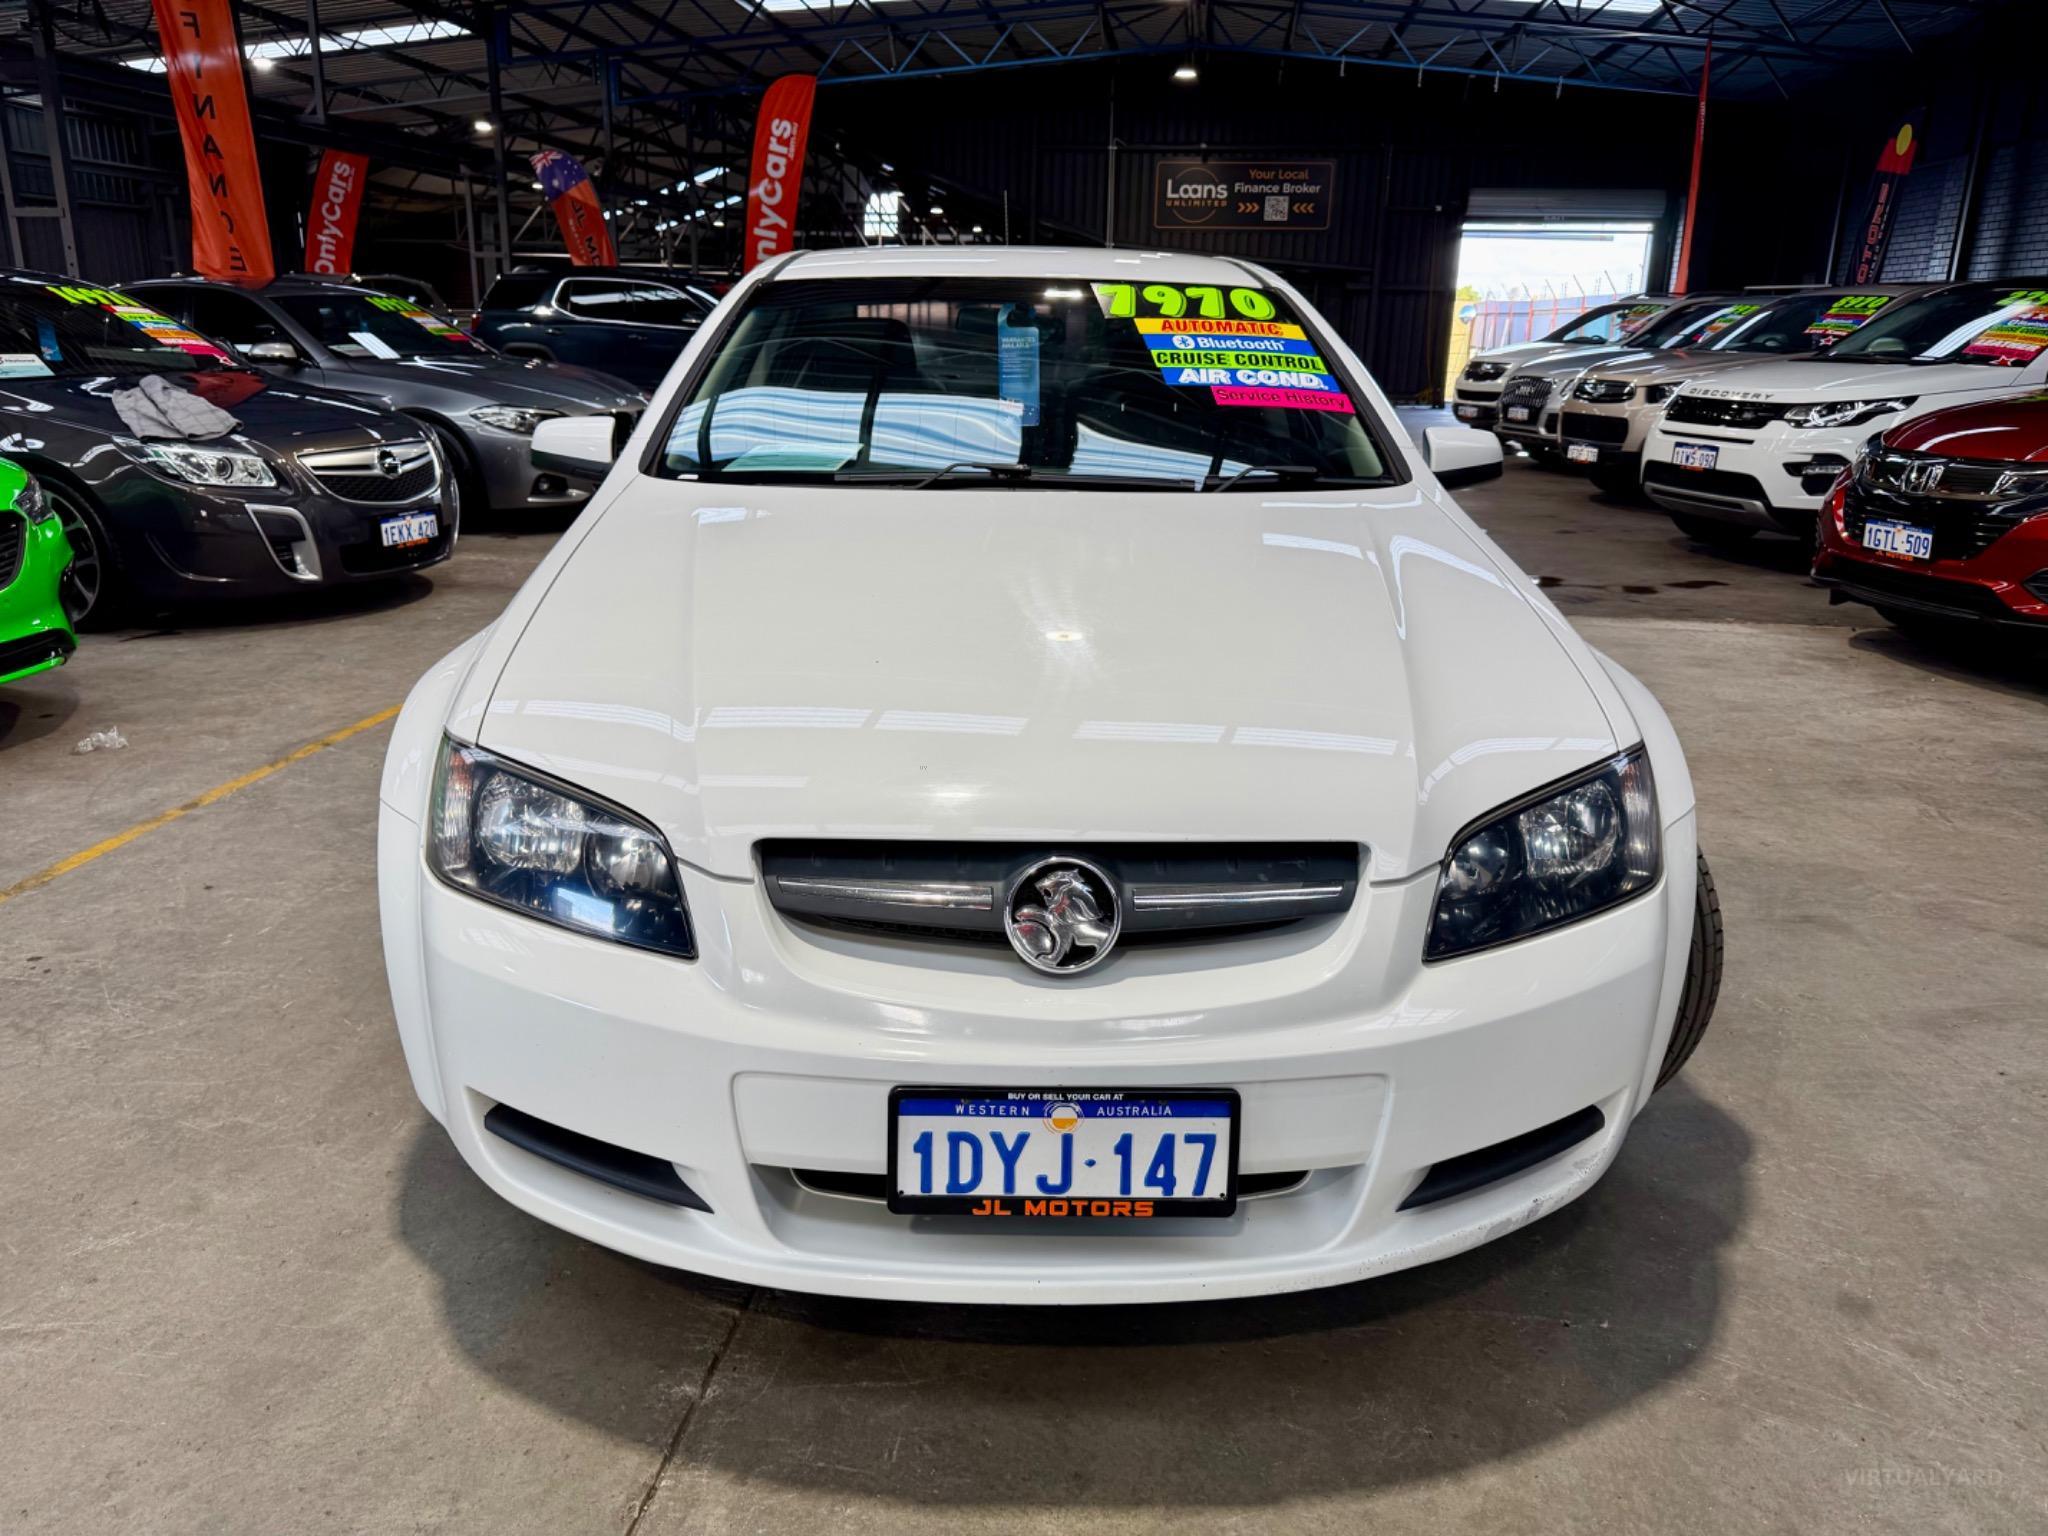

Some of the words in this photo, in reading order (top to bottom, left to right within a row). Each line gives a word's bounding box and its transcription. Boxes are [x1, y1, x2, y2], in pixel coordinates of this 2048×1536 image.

[1249, 168, 1275, 180] Your
[1279, 168, 1309, 180] Local
[1166, 178, 1229, 200] Loans
[1234, 182, 1280, 194] Finance
[1283, 182, 1321, 195] Broker
[1165, 200, 1228, 208] UNLIMITED
[1098, 283, 1276, 321] 7970
[1161, 319, 1284, 336] AUTOMATIC
[1197, 336, 1285, 352] Bluetooth
[1156, 351, 1229, 366] CRUISE
[1234, 353, 1322, 371] CONTROL
[1178, 368, 1232, 386] AIR
[1236, 369, 1329, 390] COND.
[1216, 389, 1280, 403] Service
[1285, 394, 1346, 409] History
[1688, 387, 1775, 401] DISCOVERY
[1008, 1092, 1026, 1100] BUY
[1028, 1092, 1041, 1100] OR
[1042, 1092, 1064, 1101] SELL
[1066, 1093, 1091, 1101] YOUR
[1092, 1093, 1112, 1101] CAR
[1113, 1093, 1124, 1101] AT
[955, 1104, 1030, 1117] WESTERN
[1096, 1105, 1173, 1117] AUSTRALIA
[972, 1199, 1012, 1216] JL
[1024, 1199, 1154, 1217] MOTORS
